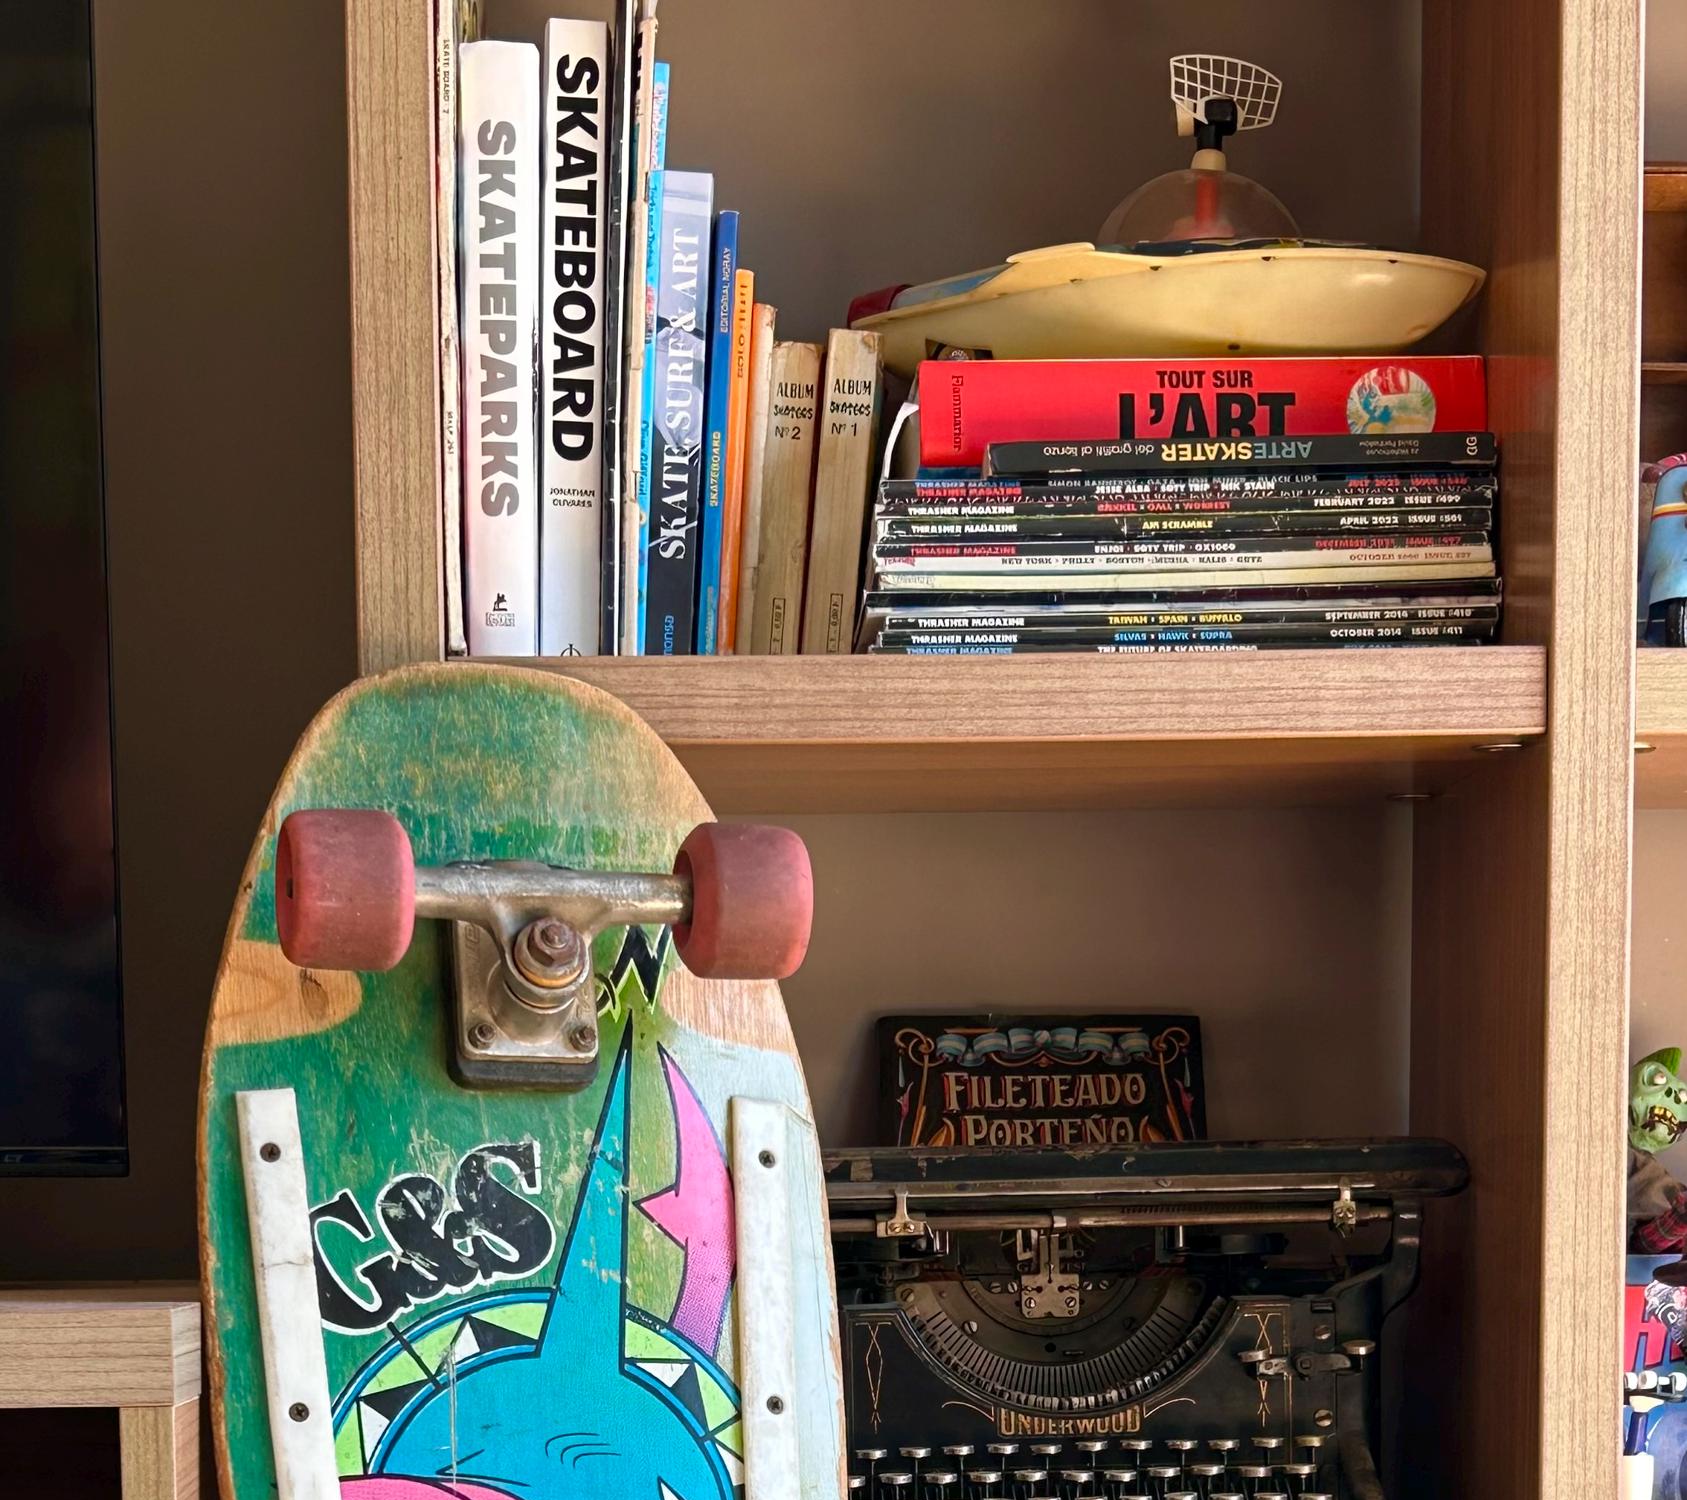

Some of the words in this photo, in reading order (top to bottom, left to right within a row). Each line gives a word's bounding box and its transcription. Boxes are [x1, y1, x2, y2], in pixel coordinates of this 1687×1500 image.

[552, 54, 601, 462] SKATEBOARD
[671, 228, 698, 299] ART
[476, 119, 520, 518] SKATEPARKS
[669, 307, 697, 333] &
[1156, 370, 1205, 389] TOUT
[1212, 370, 1253, 388] SUR
[777, 382, 814, 399] ALBUM
[834, 378, 871, 396] ALBUM
[791, 426, 801, 440] 2
[851, 423, 857, 437] 1
[916, 487, 966, 496] THRASHER
[969, 487, 1022, 496] MAGAZINE
[1188, 483, 1210, 491] TRIP
[1313, 496, 1364, 507] FEBRUARY
[1368, 497, 1395, 506] 2022
[1405, 495, 1433, 505] ISSUE
[907, 507, 959, 515] THRASHER
[961, 506, 1014, 515] MAGAZINE
[1142, 521, 1159, 530] AM
[1162, 520, 1213, 530] SCRAMBLE
[1340, 516, 1369, 525] APRIL
[1371, 516, 1399, 524] 2022
[1408, 515, 1436, 523] ISSUE
[911, 525, 962, 533] THRASHER
[964, 524, 1018, 532] MAGAZINE
[911, 546, 960, 556] THRASHER
[963, 546, 1017, 556] MAGAZINE
[1162, 544, 1186, 552] TRIP
[1001, 557, 1023, 565] NEW
[1024, 557, 1052, 565] YORK
[1158, 615, 1188, 624] SPAIN
[1325, 611, 1381, 620] SEPTEMBER
[1418, 609, 1445, 618] ISSUE
[918, 618, 969, 627] THRASHER
[972, 618, 1025, 627] MAGAZINE
[1158, 632, 1189, 640] HAWK
[1199, 631, 1233, 640] SUPRA
[1330, 628, 1375, 637] OCTOBER
[1411, 627, 1439, 636] ISSUE
[911, 635, 962, 644] THRASHER
[964, 635, 1018, 643] MAGAZINE
[943, 1072, 1147, 1112] FILETEADO
[961, 1113, 1136, 1146] PORTEÑO
[1000, 1404, 1142, 1436] UNDERWOOD
